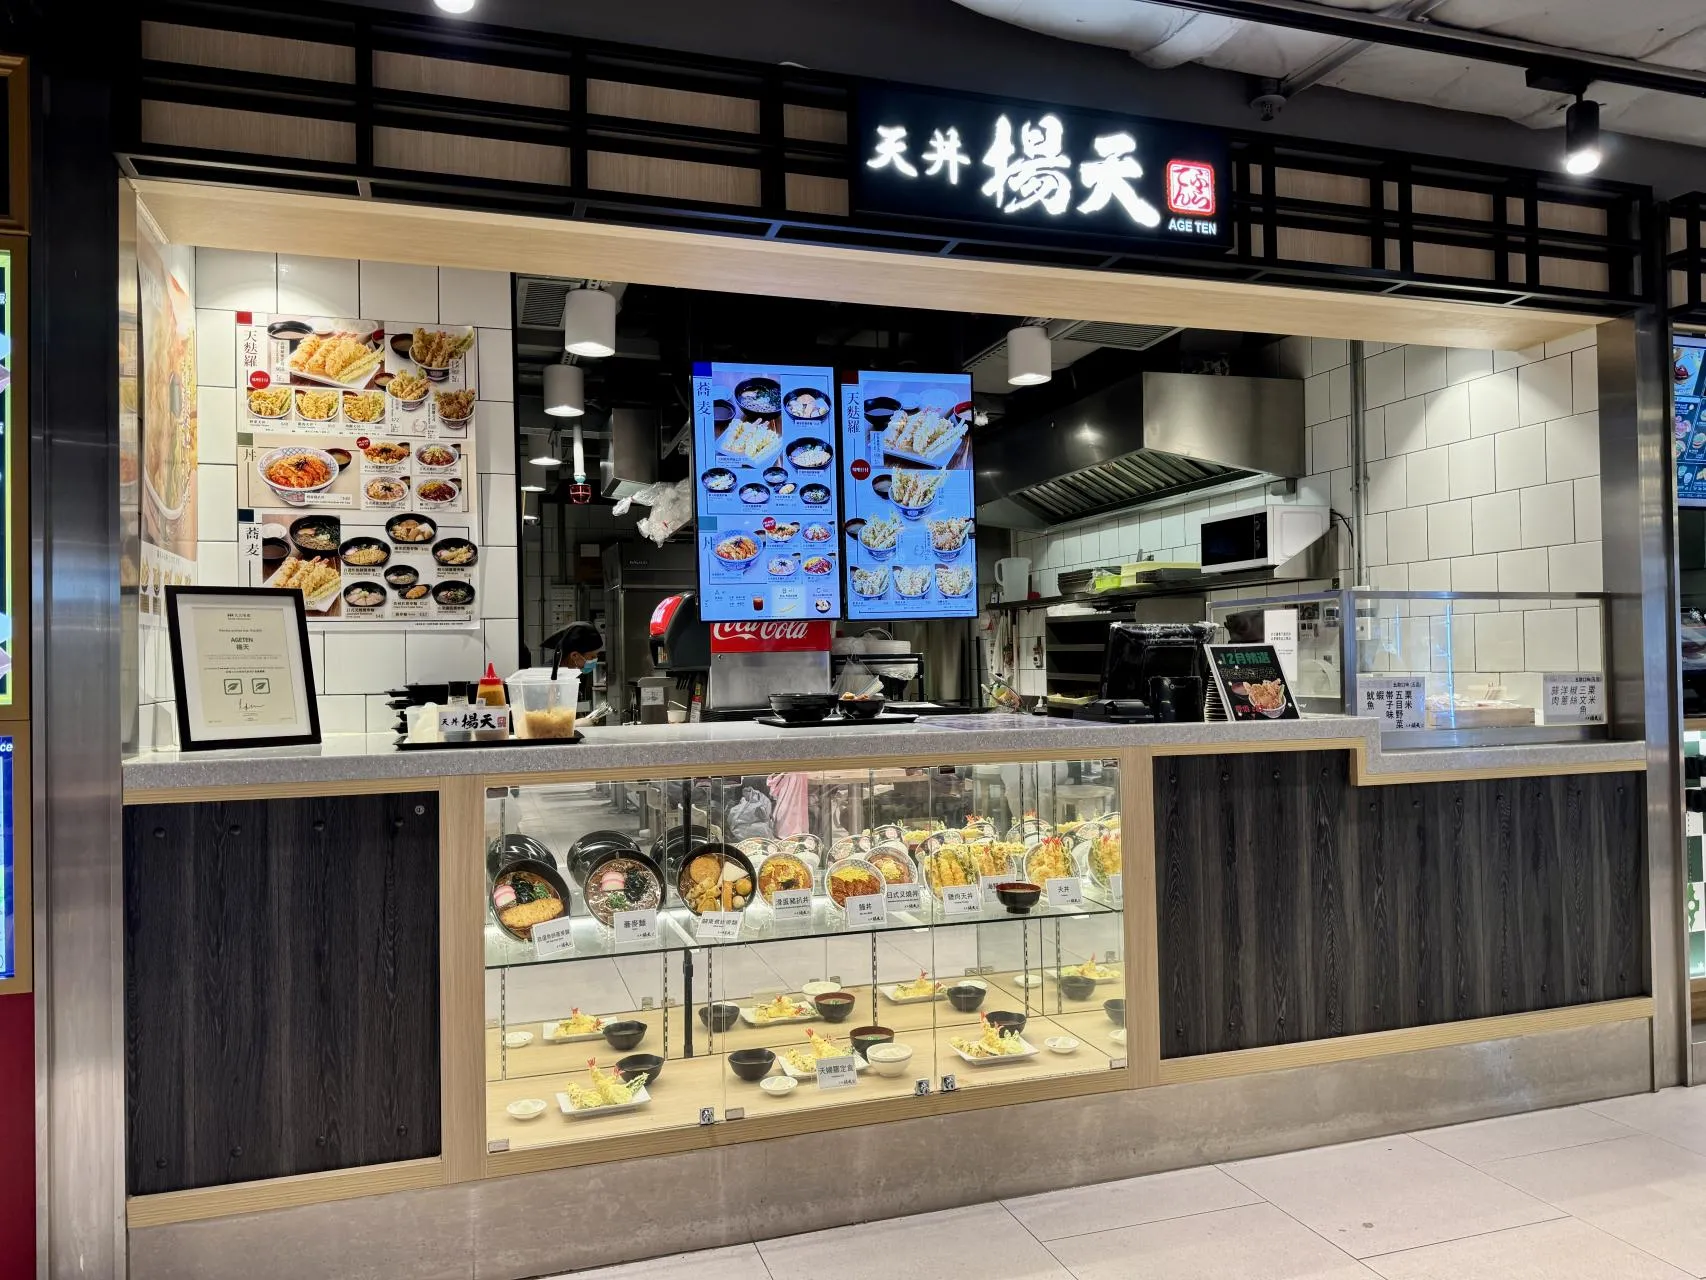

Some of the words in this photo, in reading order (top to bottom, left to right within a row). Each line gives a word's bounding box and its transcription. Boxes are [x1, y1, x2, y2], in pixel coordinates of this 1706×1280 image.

[1168, 217, 1193, 233] AGE
[1194, 220, 1218, 236] TEN
[713, 621, 809, 640] CocaCola
[1220, 651, 1271, 665] 12月精選
